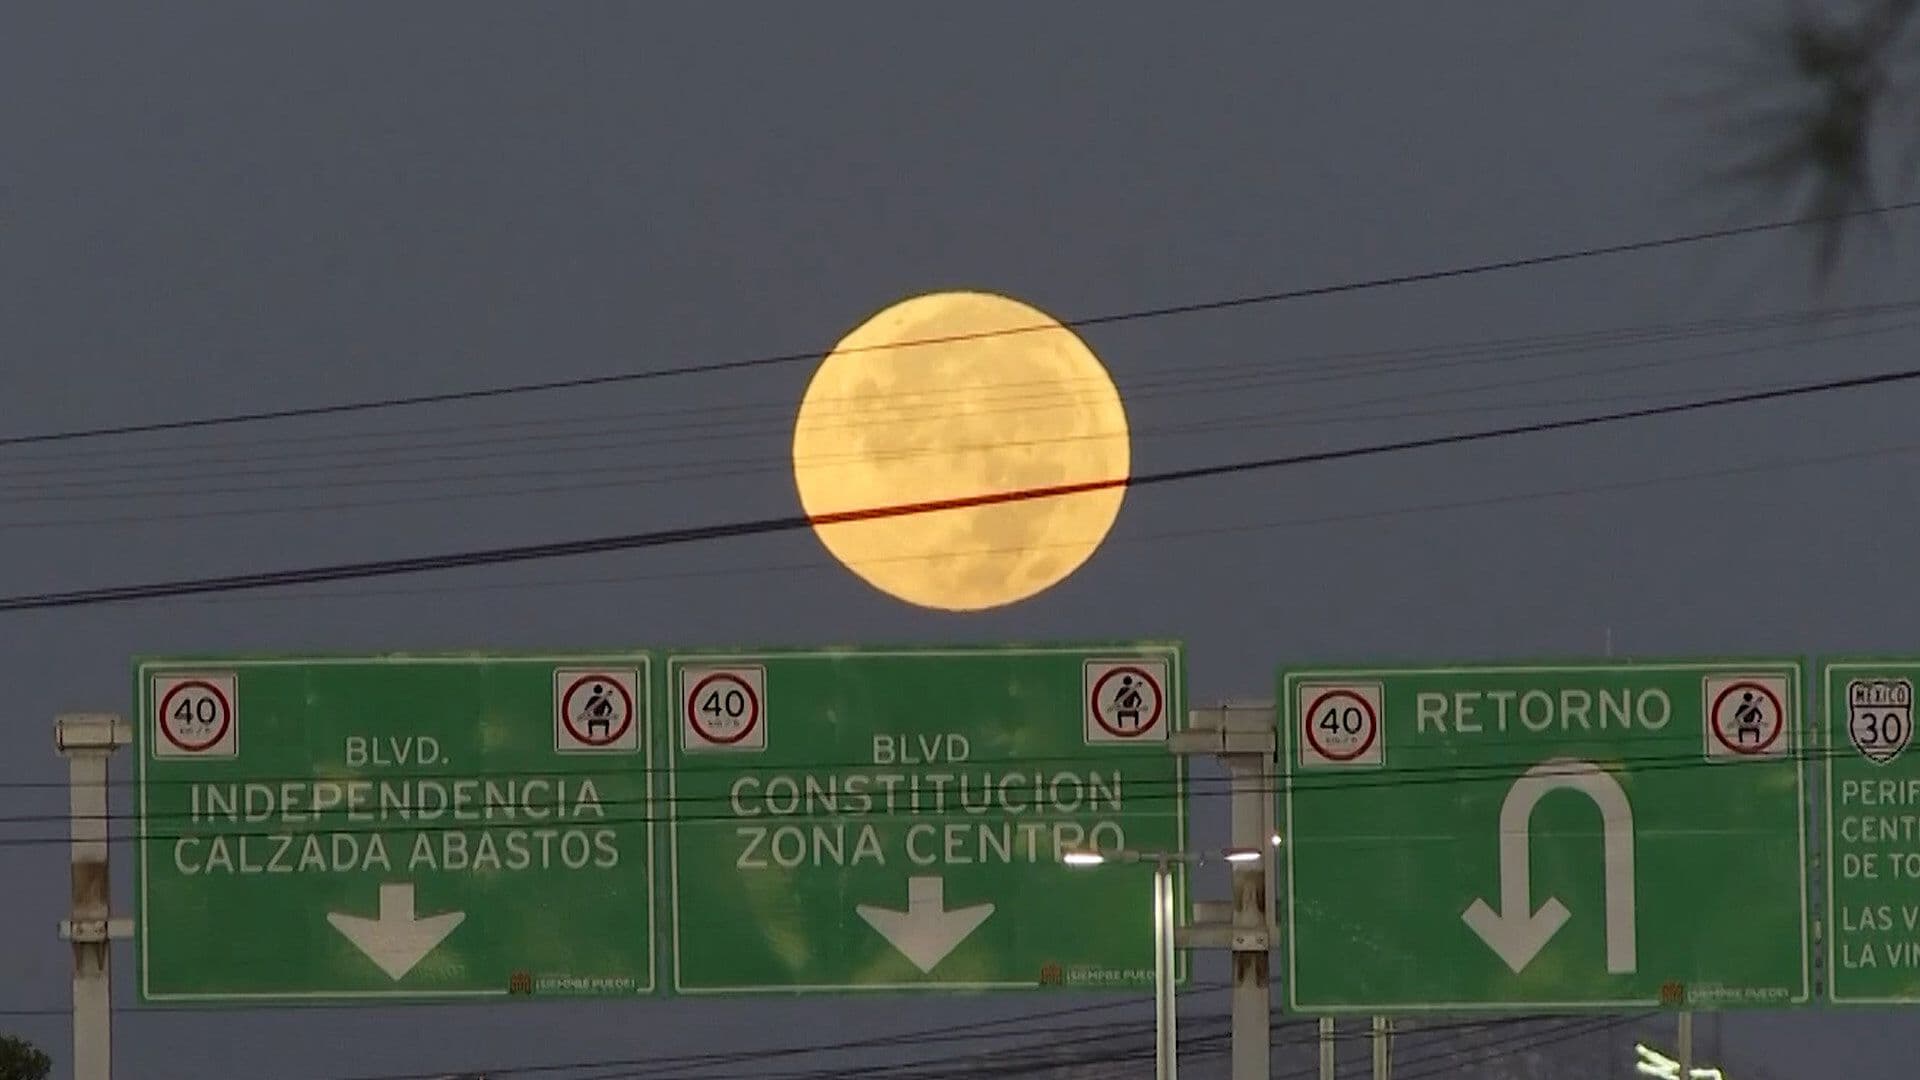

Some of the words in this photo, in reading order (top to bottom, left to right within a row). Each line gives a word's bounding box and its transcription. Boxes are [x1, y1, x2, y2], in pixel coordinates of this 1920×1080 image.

[173, 696, 216, 725] 40
[699, 689, 745, 718] 40
[1415, 688, 1673, 734] RETORNO
[1319, 707, 1363, 735] 40
[1861, 713, 1902, 744] 30
[345, 735, 450, 769] BLVD.
[871, 733, 971, 765] BLVD
[190, 778, 606, 825] INDEPENDENCIA
[729, 769, 1124, 817] CONSTITUCION
[1841, 816, 1920, 842] CENT
[173, 829, 393, 875] CALZADA
[408, 828, 620, 872] ABASTOS
[735, 824, 886, 869] ZONA
[904, 821, 1126, 866] CENTRO
[1843, 853, 1879, 879] DE
[1842, 906, 1893, 931] LAS
[1842, 943, 1877, 968] LA
